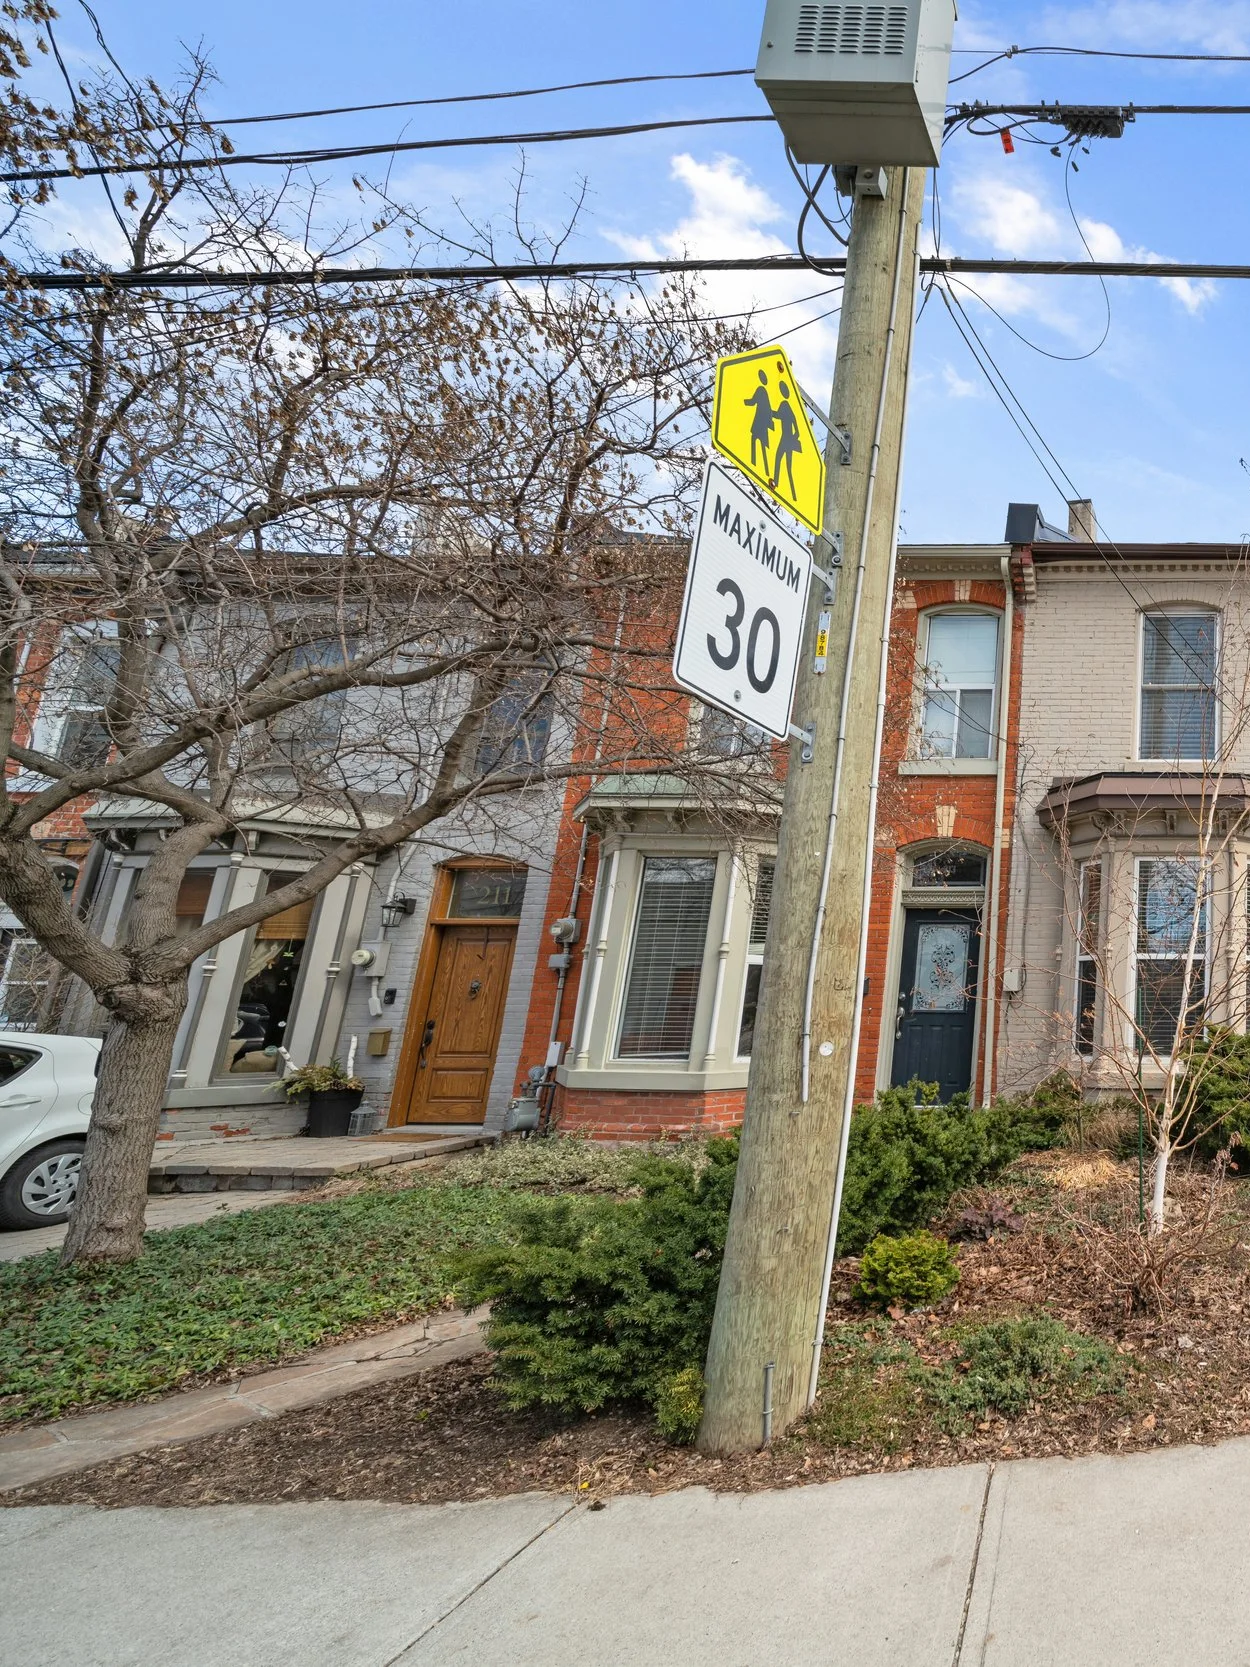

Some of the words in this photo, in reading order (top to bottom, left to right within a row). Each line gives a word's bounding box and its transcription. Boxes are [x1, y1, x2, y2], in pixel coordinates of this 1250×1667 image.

[713, 494, 801, 594] MAXIMUM
[707, 578, 780, 694] 30
[478, 886, 511, 905] 211
